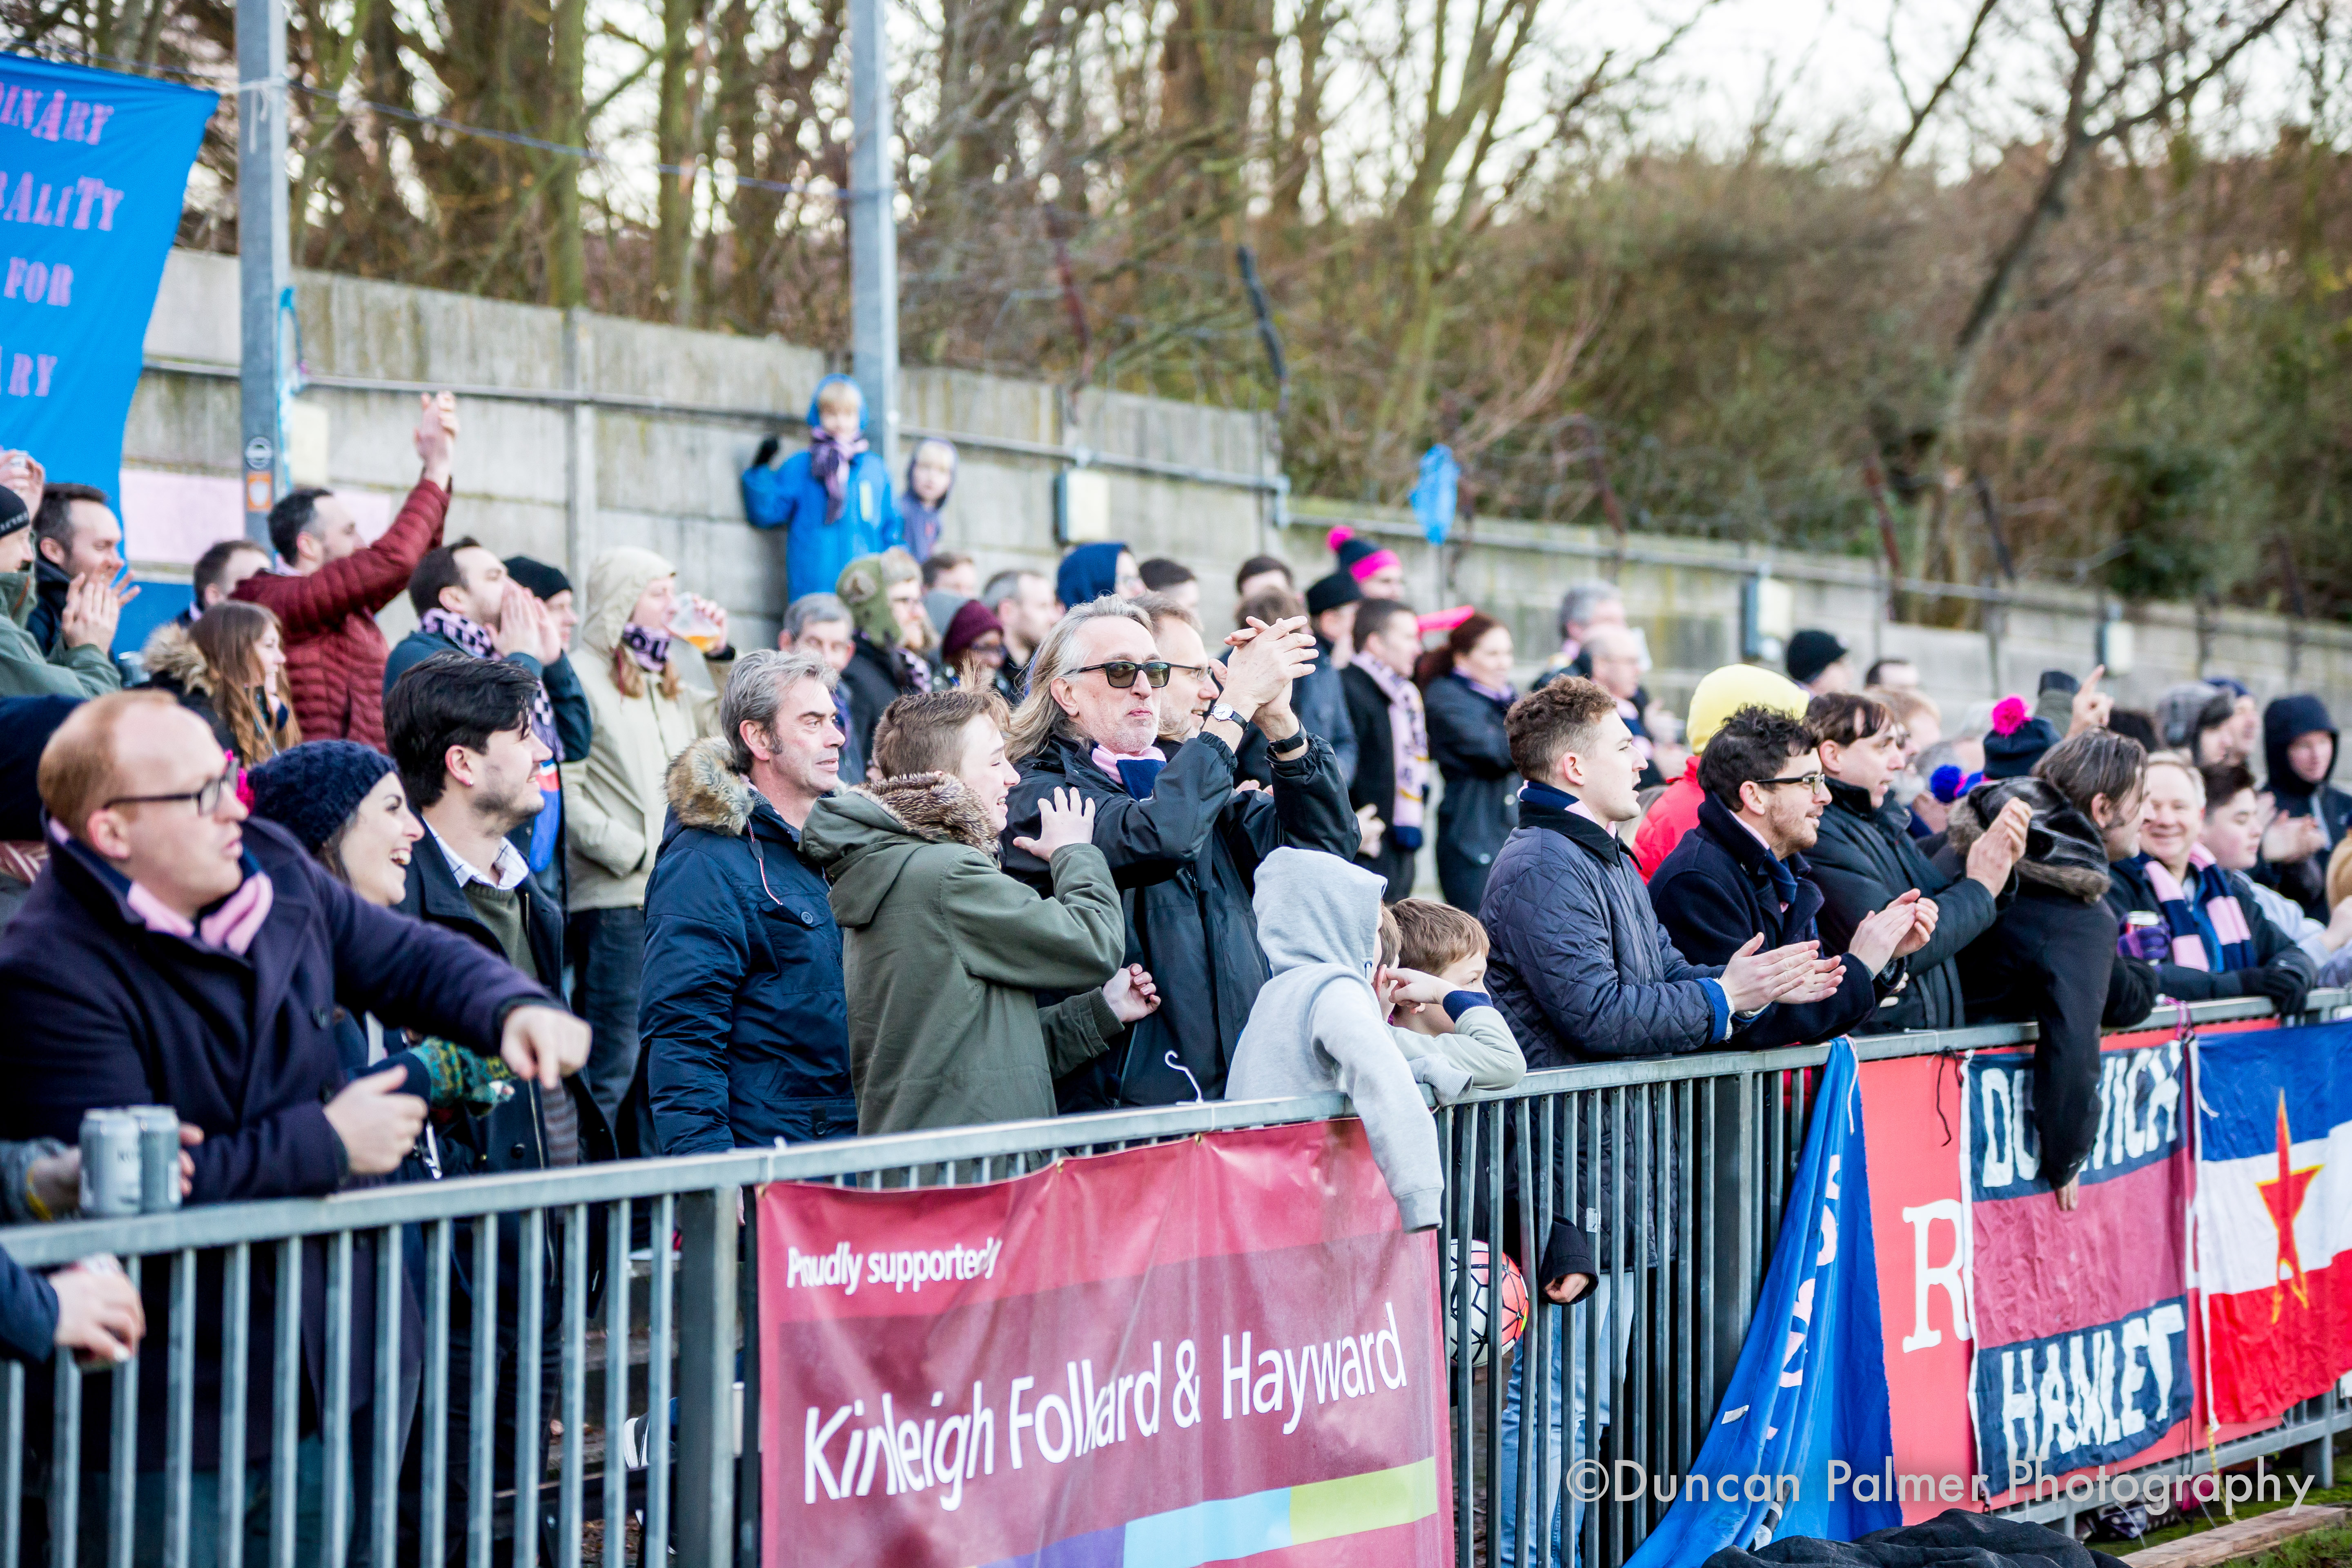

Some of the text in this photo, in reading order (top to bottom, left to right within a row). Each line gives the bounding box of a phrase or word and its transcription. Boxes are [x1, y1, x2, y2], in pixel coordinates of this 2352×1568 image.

[0, 82, 114, 145] INARY
[4, 257, 74, 307] FOR
[0, 347, 58, 397] RY
[805, 1303, 1408, 1511] Kinleigh Folkard & Hayward
[2001, 1303, 2185, 1469] HAMLET
